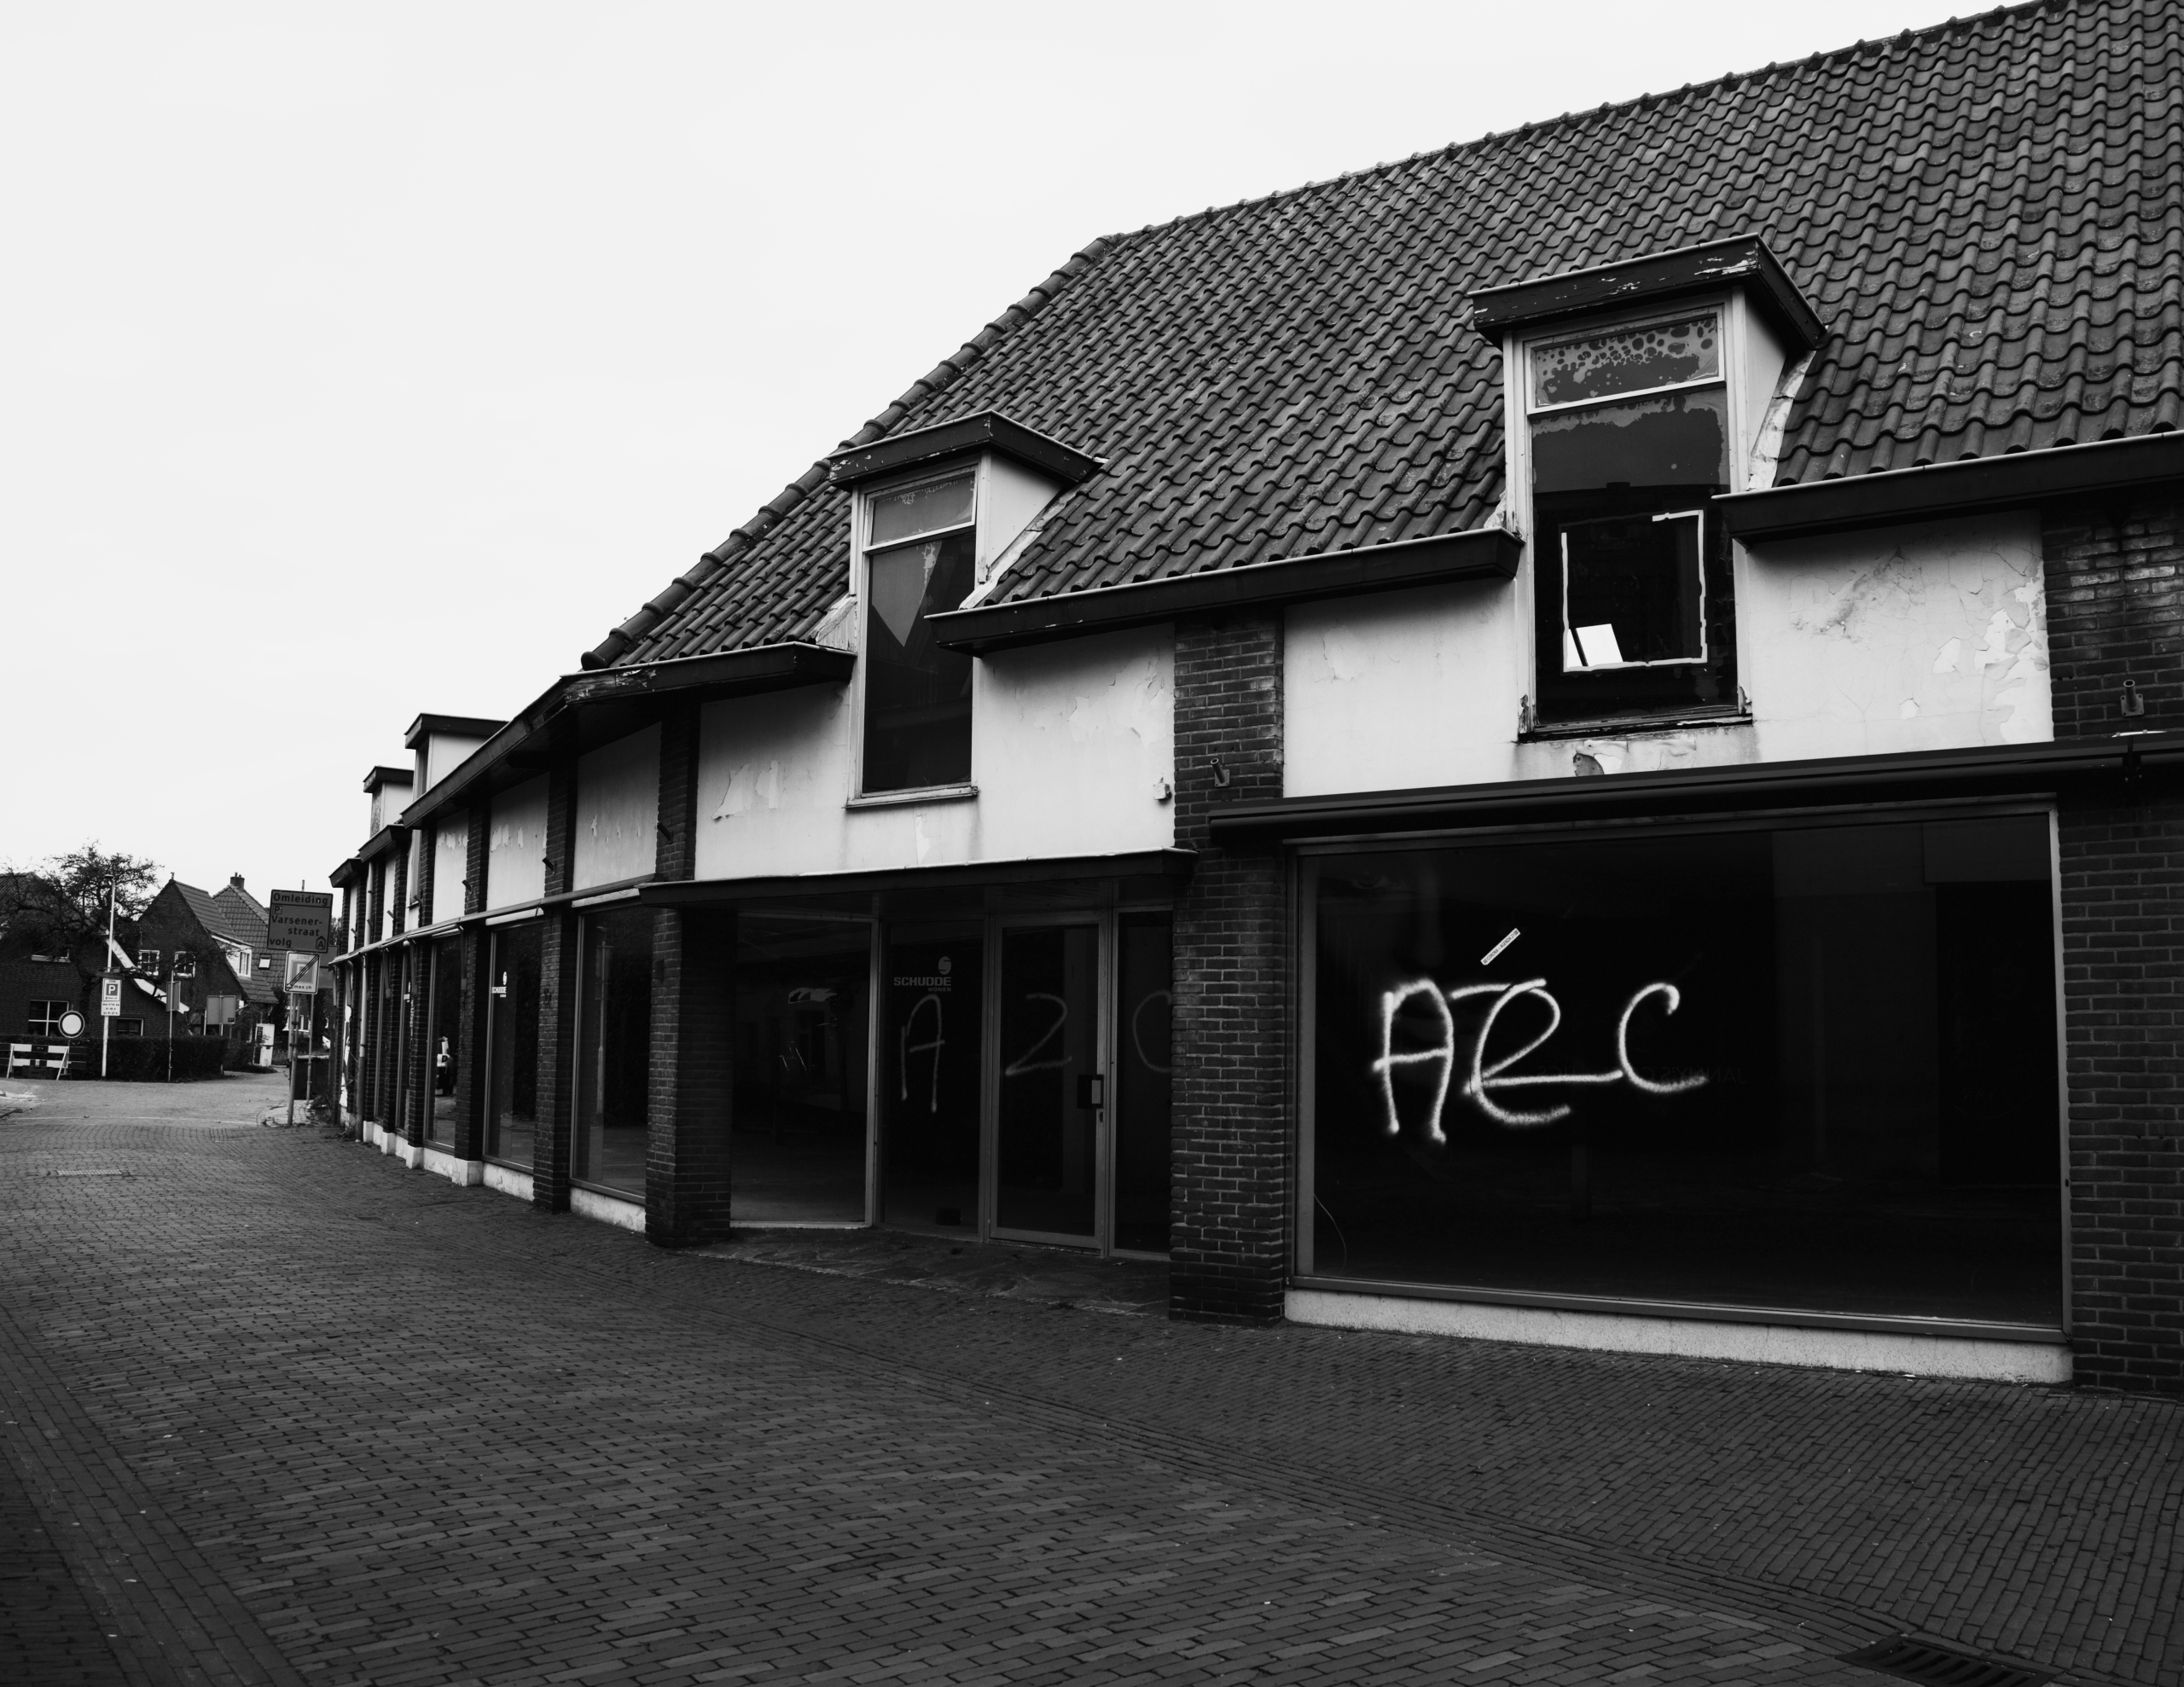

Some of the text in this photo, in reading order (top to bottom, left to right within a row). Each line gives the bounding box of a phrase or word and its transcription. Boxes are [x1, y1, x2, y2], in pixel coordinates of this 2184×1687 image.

[273, 893, 328, 907] Omleiding
[271, 915, 323, 926] Varsener-
[288, 927, 320, 936] straat
[270, 938, 292, 948] volg
[894, 977, 952, 986] SCHUDDE
